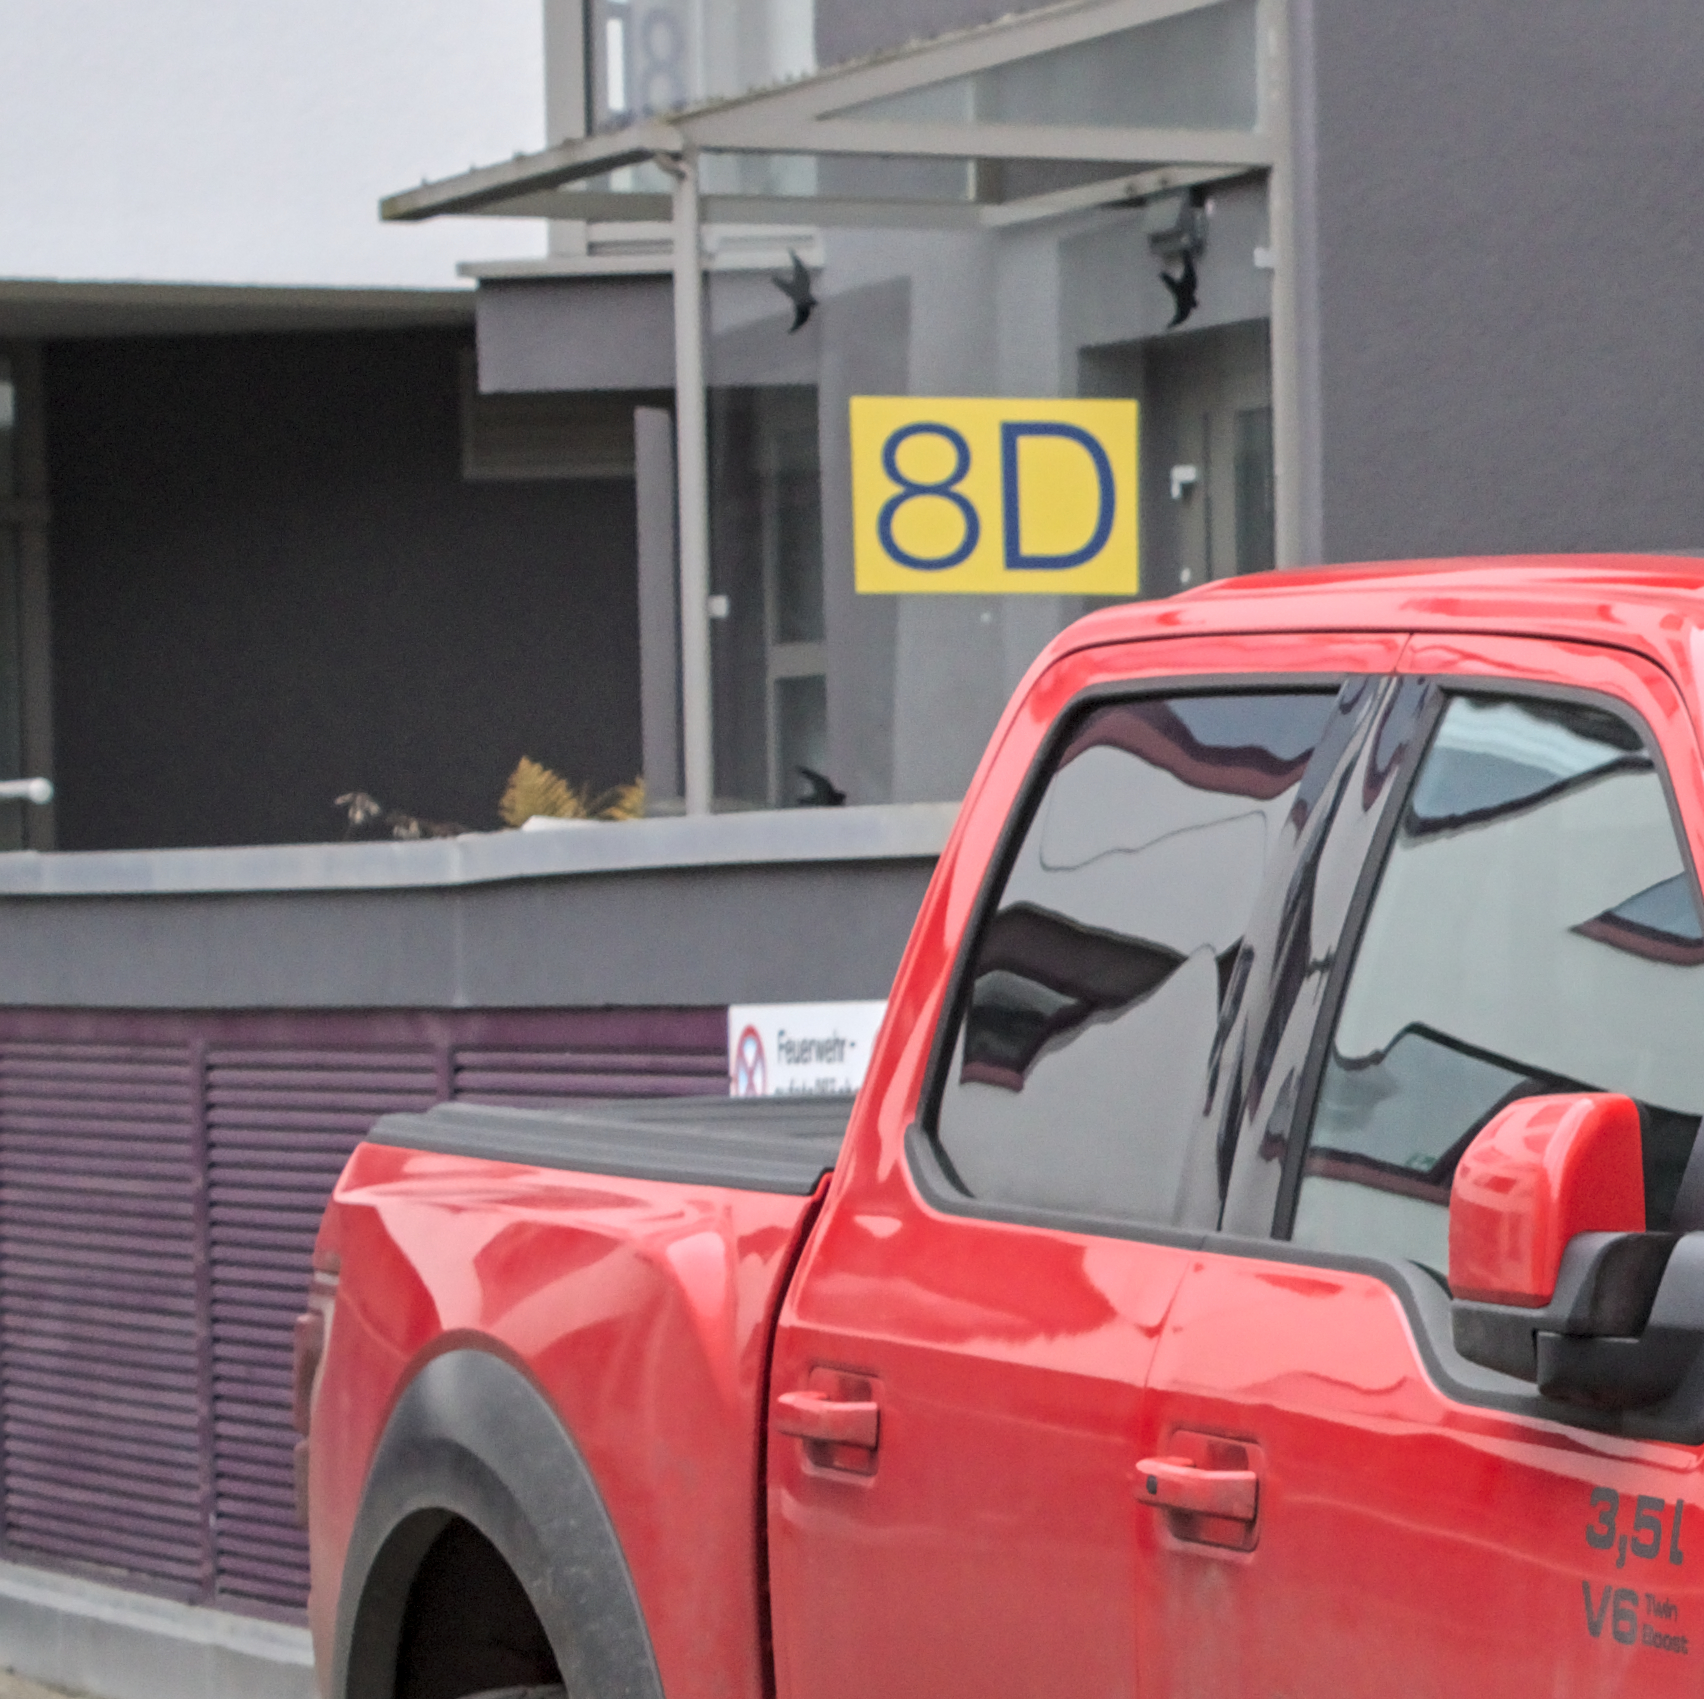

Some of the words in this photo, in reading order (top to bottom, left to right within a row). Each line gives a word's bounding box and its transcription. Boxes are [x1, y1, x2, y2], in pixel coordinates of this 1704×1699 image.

[876, 421, 1115, 571] 8D
[1582, 1580, 1639, 1646] V6
[1645, 1593, 1678, 1622] Twin
[1642, 1623, 1689, 1655] Boost
